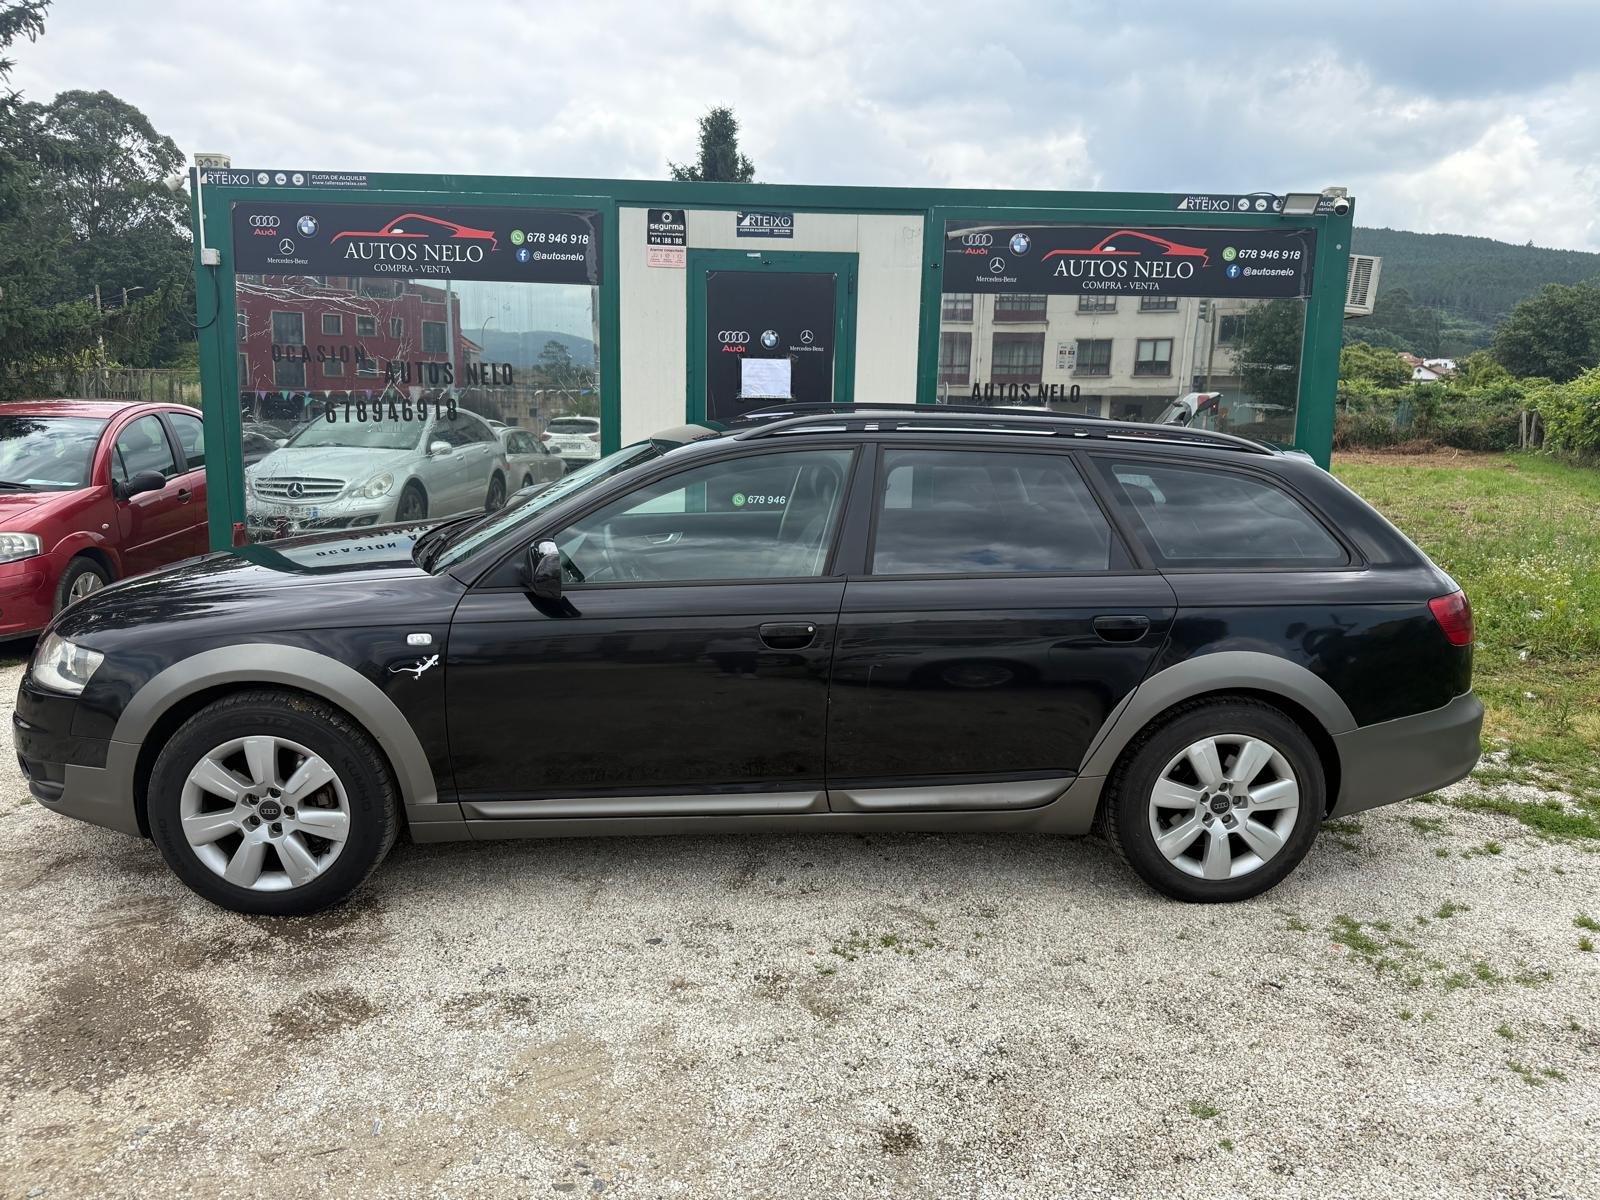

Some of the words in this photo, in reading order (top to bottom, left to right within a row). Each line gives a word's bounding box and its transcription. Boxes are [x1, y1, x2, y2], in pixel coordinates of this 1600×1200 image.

[253, 228, 277, 236] Audi
[527, 232, 546, 243] 678
[548, 233, 568, 244] 946
[570, 234, 589, 245] 918
[343, 242, 417, 261] AUTOS
[423, 244, 484, 263] NELO
[532, 251, 584, 261] @autosnelo
[964, 247, 988, 255] Audi
[1238, 249, 1258, 259] 678
[1260, 249, 1280, 259] 946
[1282, 250, 1301, 260] 918
[266, 257, 309, 265] Mercedes-Benz
[374, 263, 412, 273] COMPRA
[419, 264, 452, 274] VENTA
[1053, 259, 1128, 277] AUTOS
[1133, 260, 1194, 280] NELO
[1243, 266, 1294, 276] @autosnelo
[975, 275, 1017, 283] Mercedes-Benz
[1082, 280, 1122, 290] COMPRA
[1128, 281, 1160, 291] VENTA
[272, 344, 365, 363] OCASION
[722, 344, 746, 353] Audi
[385, 362, 453, 385] AUTOS
[466, 362, 514, 386] NELO
[971, 382, 1031, 402] AUTOS
[1037, 383, 1081, 403] NELO
[325, 399, 458, 424] 678946918
[747, 495, 765, 504] 678
[767, 495, 786, 505] 946
